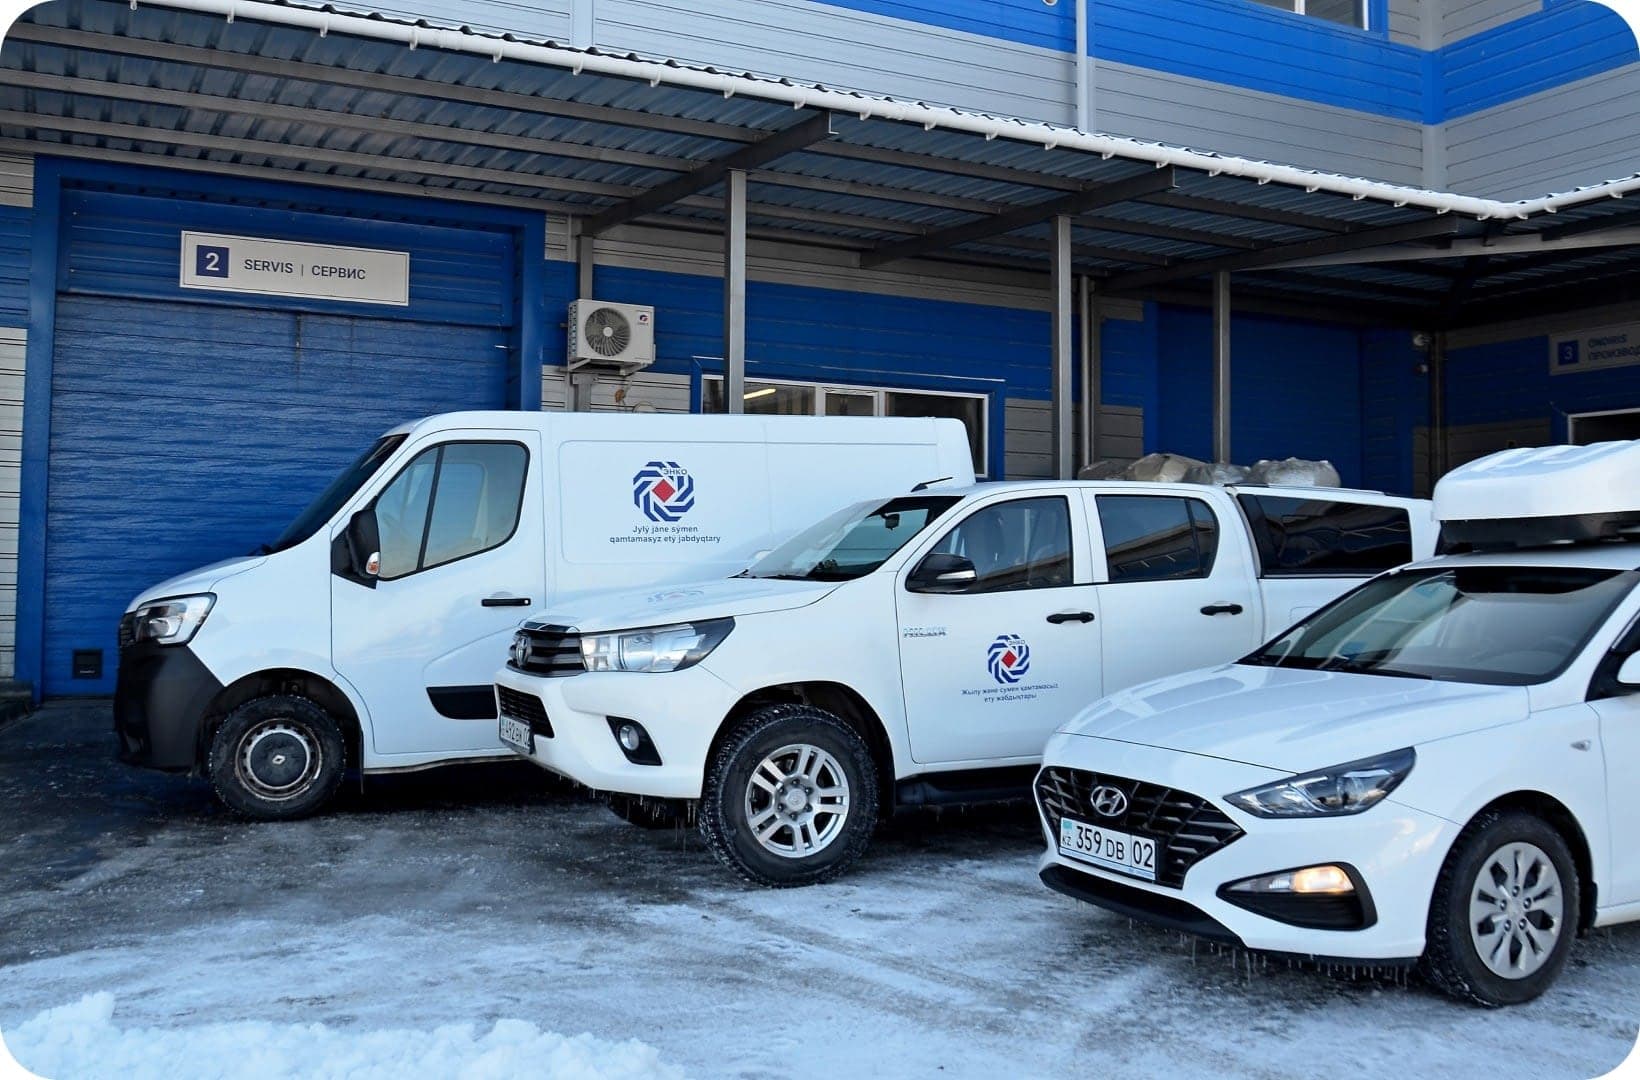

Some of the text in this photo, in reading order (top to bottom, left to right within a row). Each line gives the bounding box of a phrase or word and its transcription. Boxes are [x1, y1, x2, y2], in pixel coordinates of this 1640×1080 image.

[205, 252, 366, 280] 2 SERVIS СЕРВИС
[663, 468, 688, 476] ЭНКО
[1076, 825, 1102, 854] 359
[1106, 838, 1125, 860] DB
[1133, 840, 1154, 868] 02
